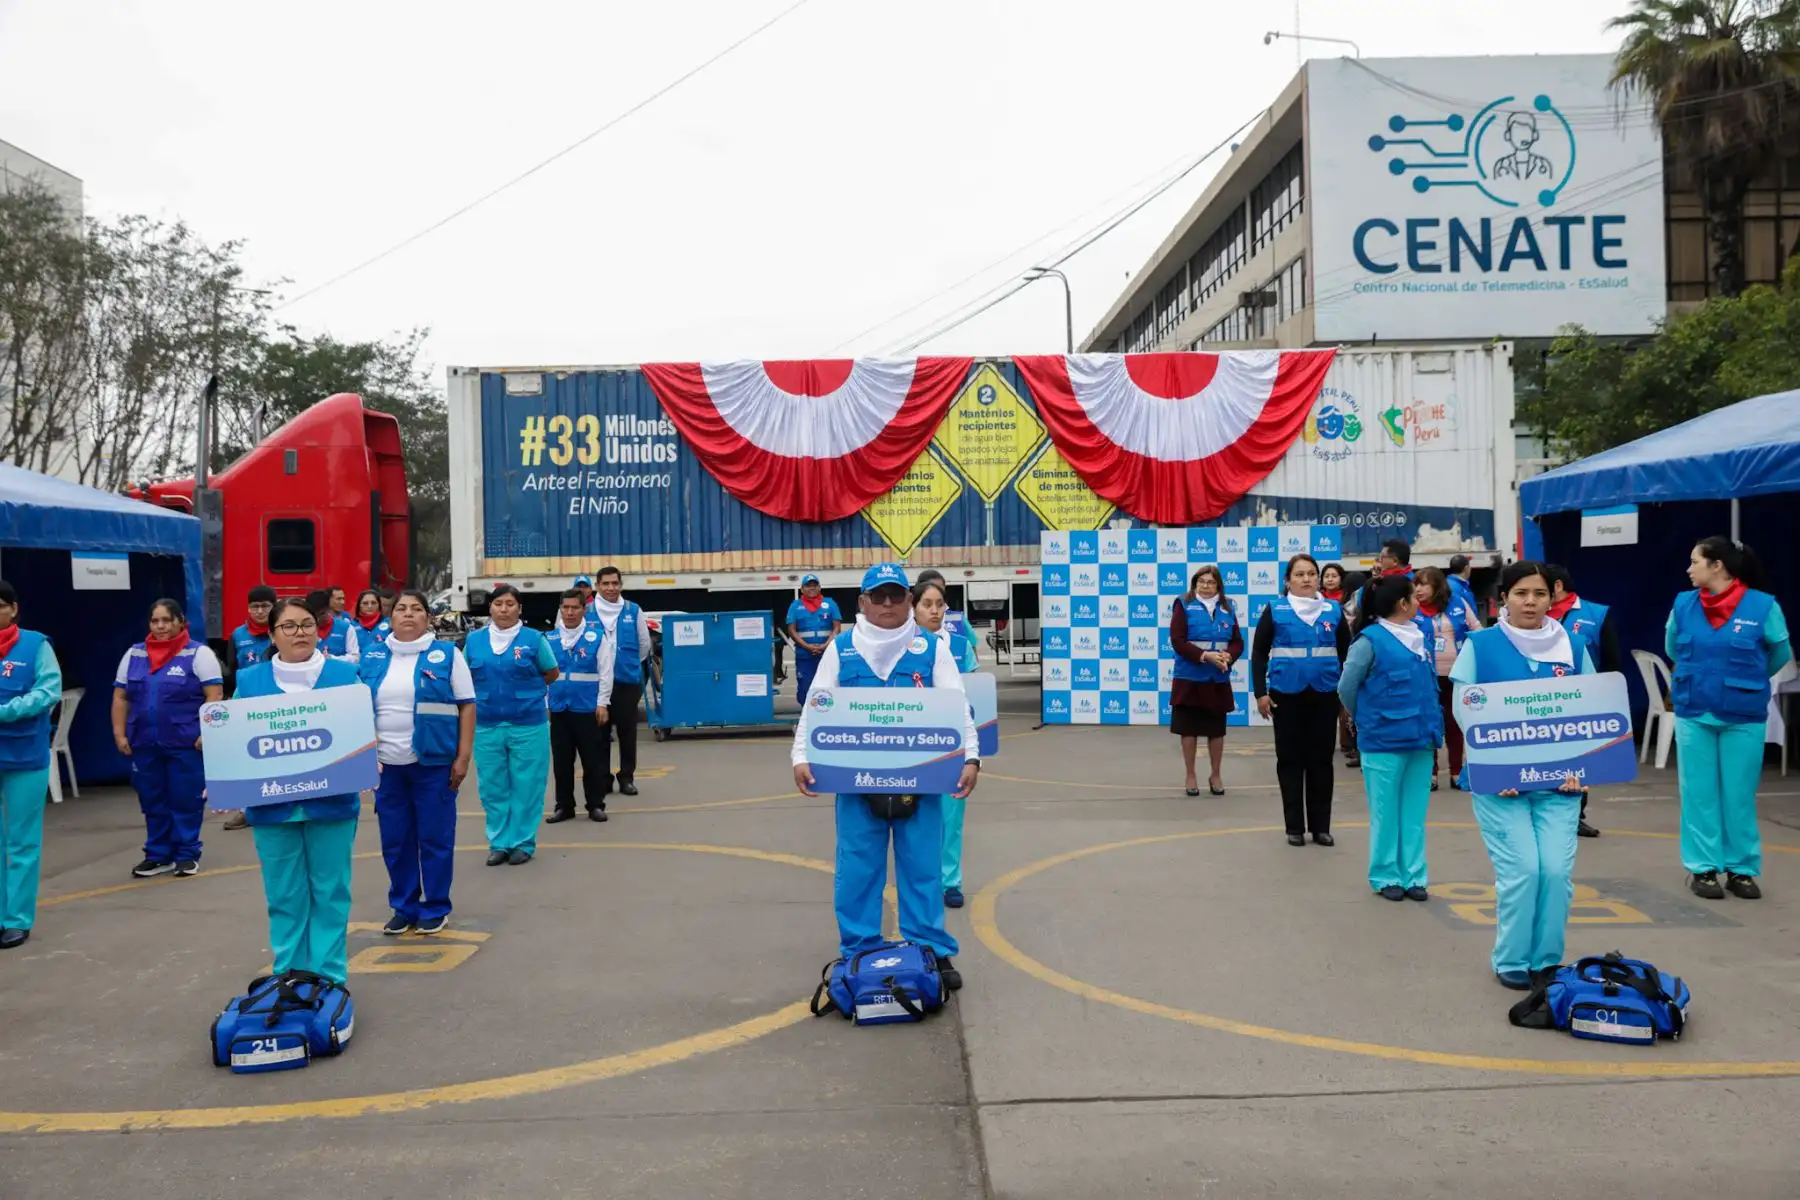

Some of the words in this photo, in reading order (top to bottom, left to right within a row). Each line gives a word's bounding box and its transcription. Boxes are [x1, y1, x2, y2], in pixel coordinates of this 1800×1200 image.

[1353, 215, 1628, 274] CENATE
[1353, 282, 1398, 293] Centro
[1402, 281, 1458, 293] Nacional
[1462, 281, 1478, 292] de
[1482, 280, 1566, 292] Telemedicina
[1578, 277, 1629, 289] EsSalud
[981, 387, 992, 402] 2
[605, 414, 677, 436] Millones
[958, 421, 1017, 432] recipientes
[520, 414, 601, 466] #33
[605, 437, 677, 463] Unidos
[523, 472, 565, 491] Ante
[568, 471, 582, 490] el
[586, 470, 671, 490] Fenómeno
[1033, 469, 1068, 478] Elimina
[1039, 482, 1052, 490] de
[569, 497, 585, 515] El
[588, 496, 629, 515] Niño
[1504, 692, 1553, 706] Hospital
[1554, 689, 1582, 701] Perú
[247, 705, 297, 721] Hospital
[300, 702, 327, 715] Perú
[849, 702, 896, 714] Hospital
[899, 702, 924, 712] Perú
[1526, 706, 1553, 717] llega
[1555, 705, 1563, 713] a
[270, 720, 298, 731] llega
[300, 719, 307, 727] a
[869, 714, 895, 724] llega
[1474, 718, 1621, 744] Lambayeque
[258, 735, 322, 756] Puno
[817, 732, 859, 745] Costa,
[862, 732, 905, 745] Sierra
[907, 735, 917, 748] y
[918, 732, 956, 745] Selva
[285, 779, 328, 794] EsSalud
[877, 776, 917, 788] EsSalud
[252, 1038, 278, 1053] 24
